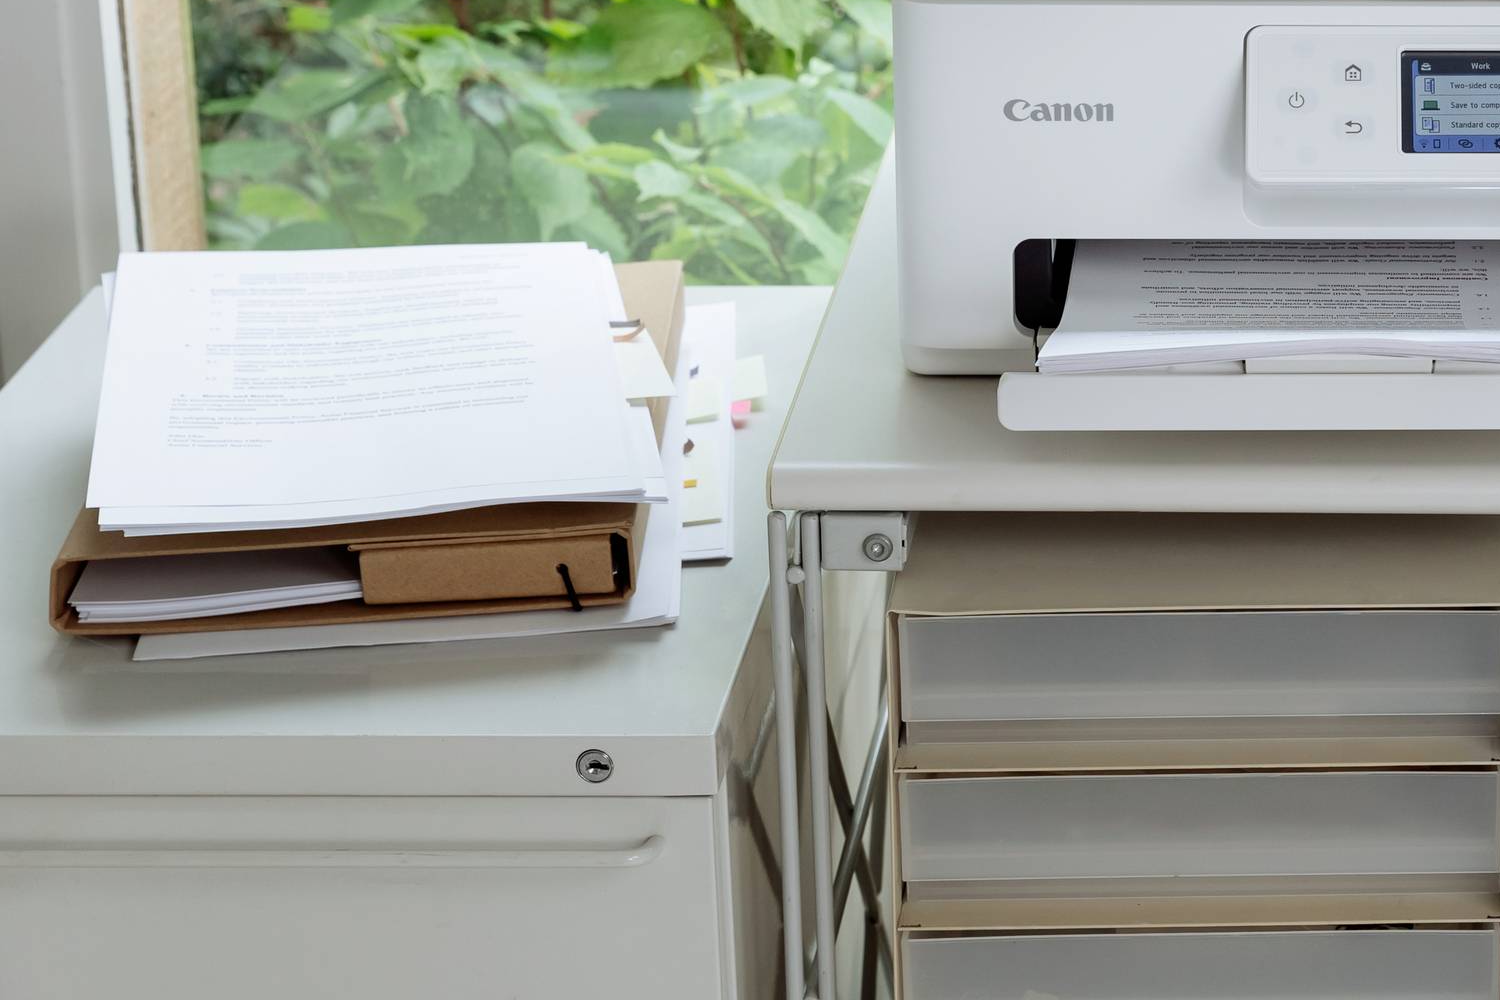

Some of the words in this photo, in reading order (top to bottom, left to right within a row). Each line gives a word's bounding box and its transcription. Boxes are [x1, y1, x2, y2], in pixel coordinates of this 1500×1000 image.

[1471, 62, 1491, 70] Work
[1450, 82, 1487, 90] Two-sided
[1003, 99, 1114, 122] Canon
[1451, 121, 1484, 129] Standard
